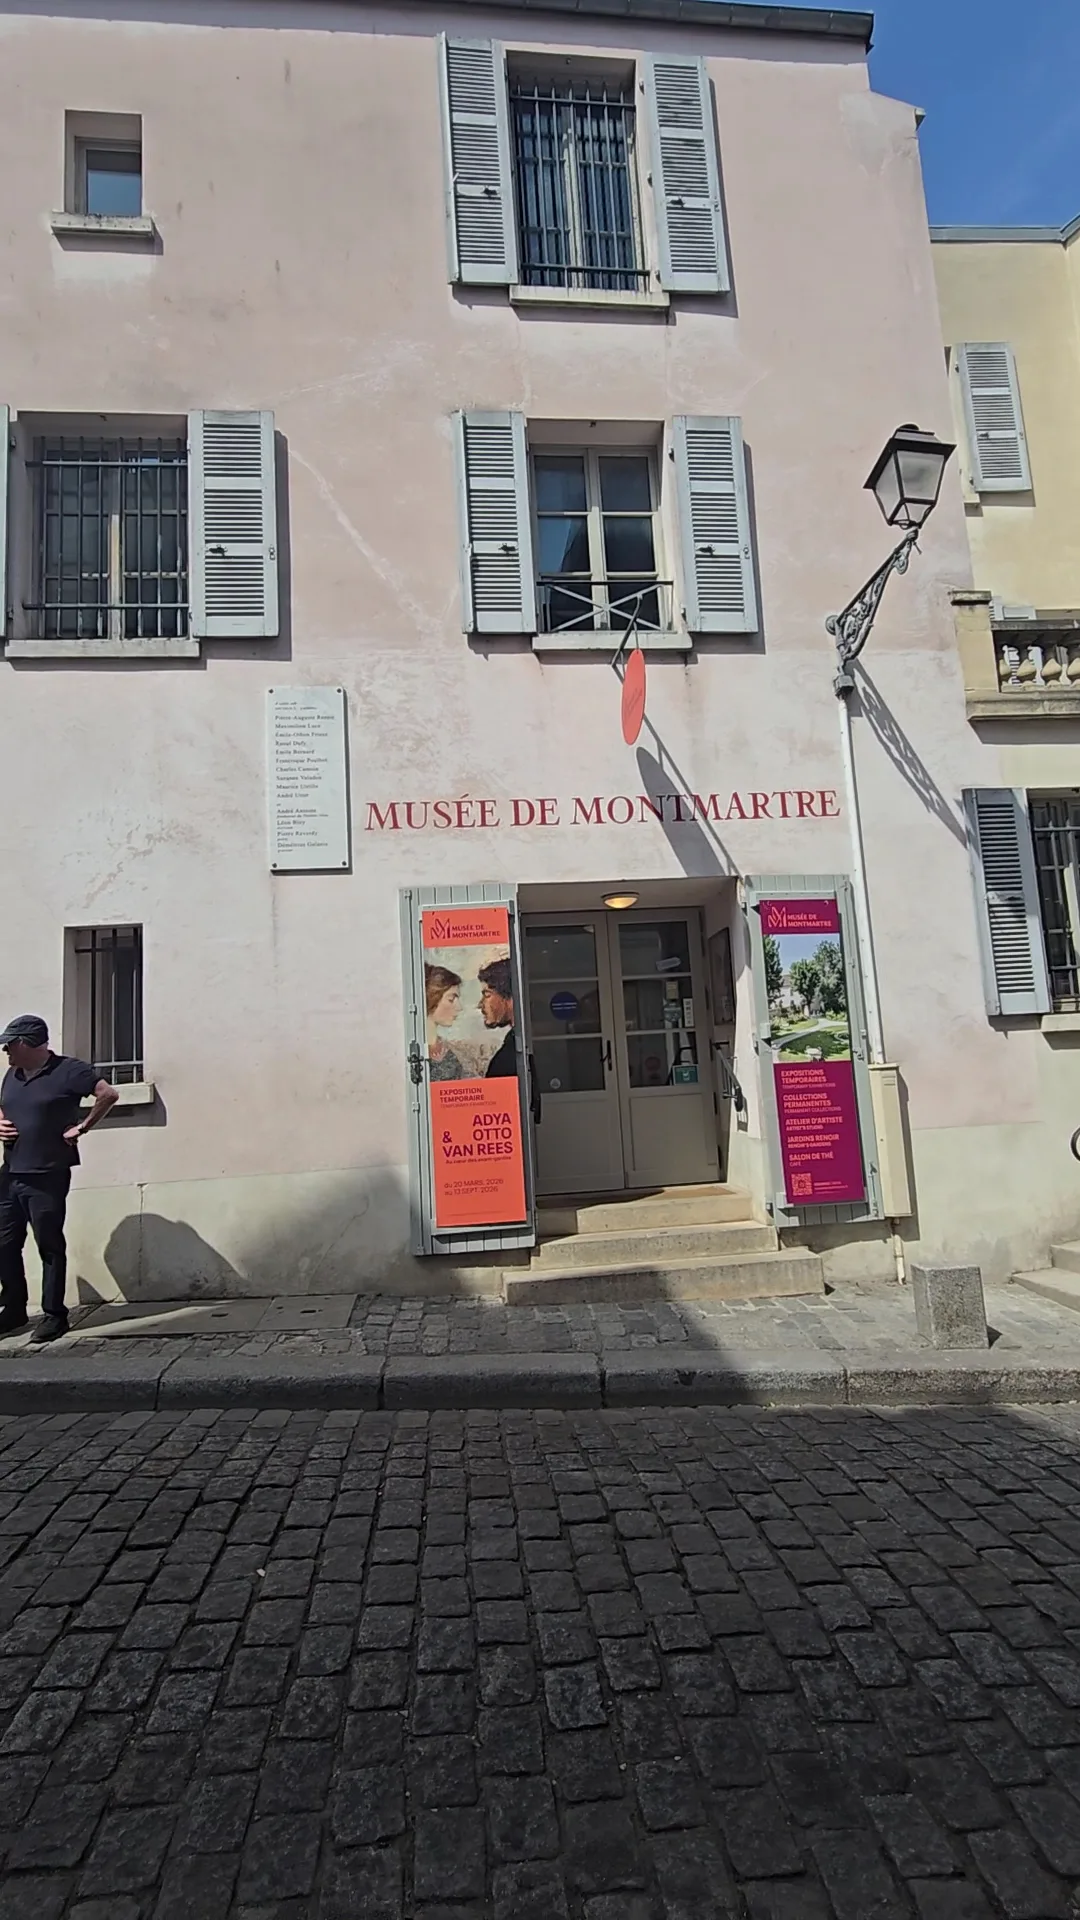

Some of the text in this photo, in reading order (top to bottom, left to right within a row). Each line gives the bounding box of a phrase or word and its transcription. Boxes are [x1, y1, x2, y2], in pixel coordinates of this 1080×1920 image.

[364, 790, 841, 831] MUSÉE DE MONTMARTRE
[788, 920, 832, 928] MONTMARTRE
[452, 930, 501, 939] MONTMARTRE
[781, 1069, 824, 1077] EXPOSITIONS
[781, 1076, 827, 1084] TEMPORAIRES
[440, 1087, 482, 1096] EXPOSITION
[440, 1094, 485, 1103] TEMPORAIRE
[783, 1093, 828, 1101] COLLECTIONS
[783, 1100, 832, 1108] PERMANENTES
[472, 1112, 512, 1127] ADYA
[442, 1127, 512, 1143] & OTTO
[787, 1133, 840, 1143] JARDINS RENOIR
[442, 1141, 514, 1158] VAN REES
[789, 1153, 811, 1161] SALON
[821, 1151, 834, 1159] THÉ
